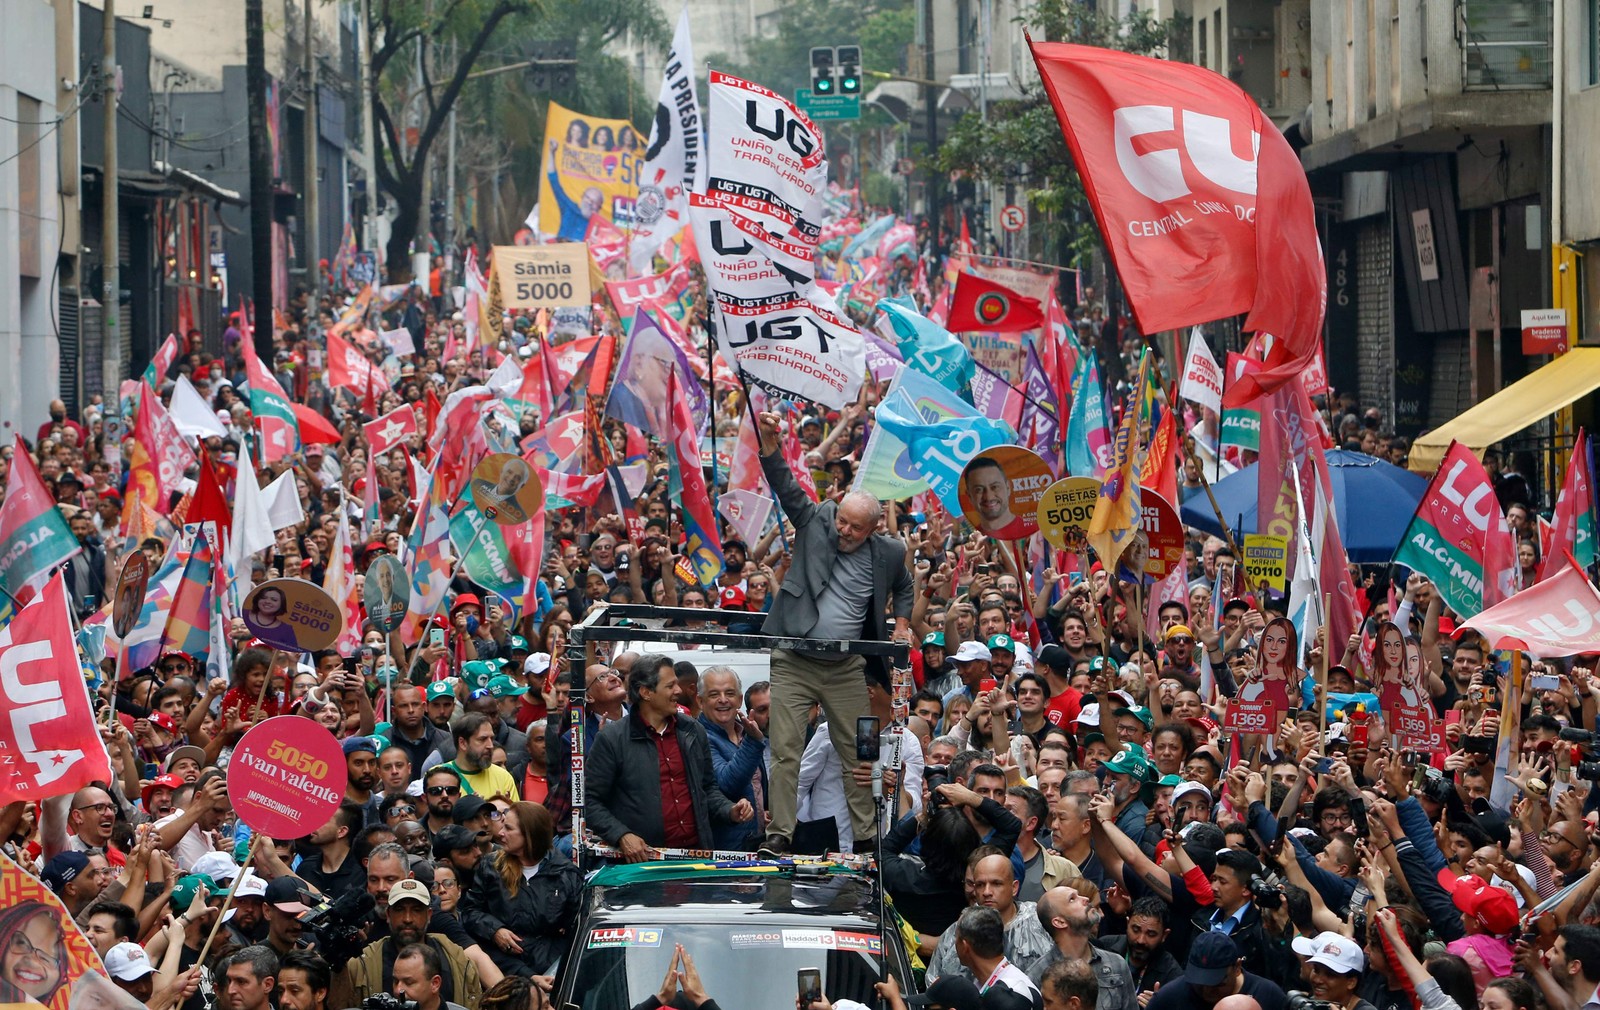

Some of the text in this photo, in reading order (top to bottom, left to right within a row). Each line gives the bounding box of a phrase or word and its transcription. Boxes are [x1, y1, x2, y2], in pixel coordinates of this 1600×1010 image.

[719, 75, 743, 87] UGT
[746, 82, 769, 95] UGT
[731, 137, 773, 154] UNIÃO
[717, 182, 742, 195] UGT
[745, 186, 769, 200] UGT
[698, 196, 723, 207] UGT
[715, 191, 788, 220] UGT UGT UGT
[744, 220, 764, 237] UGT
[766, 235, 788, 251] UGT
[789, 245, 814, 259] UGT
[514, 261, 571, 275] Sâmia
[713, 259, 757, 271] UNIÃO
[517, 282, 573, 300] 5000
[738, 299, 762, 307] UGT
[766, 295, 790, 305] UGT
[738, 306, 762, 315] UGT
[765, 303, 789, 312] UGT
[1531, 327, 1561, 336] bradesco
[775, 345, 848, 384] GERAL DOS
[1188, 371, 1222, 396] 50110
[764, 384, 788, 400] UGT
[1012, 474, 1052, 491] KIKO
[1055, 490, 1097, 503] PRETAS
[464, 508, 514, 584] ALCKMIN
[1247, 548, 1281, 558] EDIRNE
[1251, 558, 1277, 566] MARIA
[1246, 566, 1282, 577] 50110
[294, 600, 335, 621] Sâmia
[289, 611, 330, 632] 5000
[1230, 712, 1267, 727] 1369
[1398, 717, 1426, 733] 1369
[267, 739, 329, 780] 5050
[572, 758, 583, 773] 13
[1134, 762, 1146, 772] LULA
[240, 747, 339, 804] ivan valente
[251, 771, 302, 797] DEPUTADO FEDERAL
[247, 789, 302, 821] IMPRESCINDÍVEL!
[687, 850, 711, 858] 400
[715, 853, 746, 862] Haddad
[593, 929, 633, 940] LULA
[638, 931, 659, 943] 13
[785, 934, 834, 945] Haddad 13
[838, 936, 867, 945] LULA
